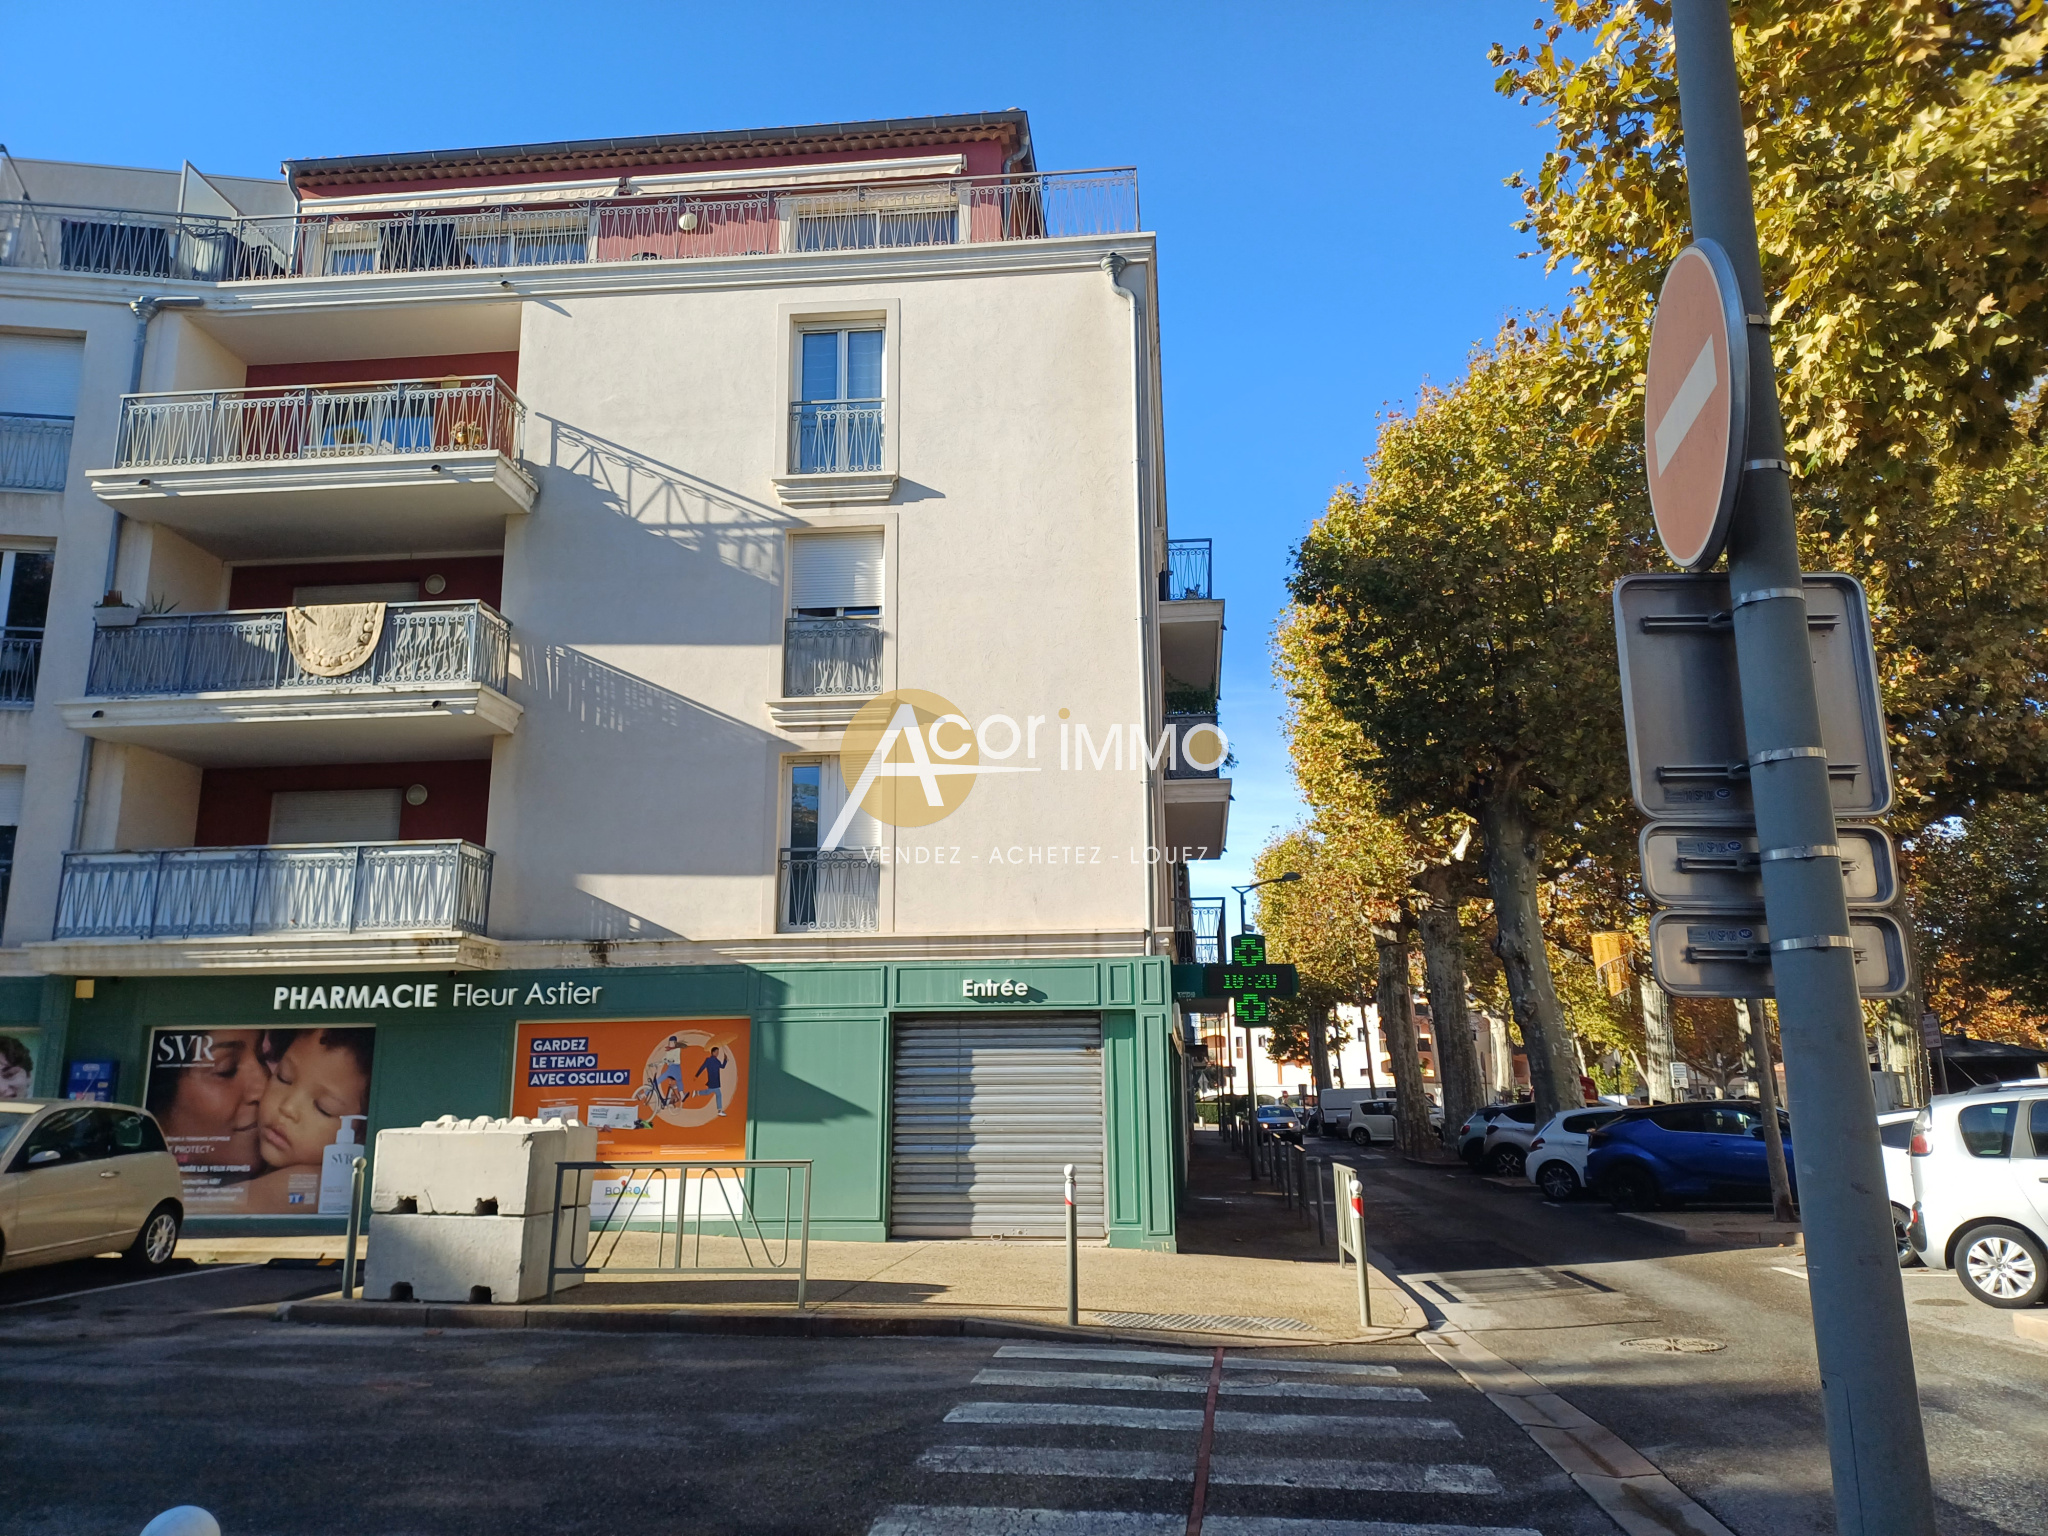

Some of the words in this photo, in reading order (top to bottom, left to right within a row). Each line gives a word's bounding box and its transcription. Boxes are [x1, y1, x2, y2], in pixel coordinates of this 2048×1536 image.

[962, 978, 1029, 997] Entrée
[273, 984, 438, 1010] PHARMACIE
[452, 983, 519, 1007] Fleur
[524, 982, 603, 1006] Astier
[157, 1035, 215, 1062] SVR
[533, 1040, 587, 1053] GARDEZ
[532, 1056, 547, 1068] LE
[550, 1055, 596, 1068] TEMPO
[530, 1073, 566, 1086] AVEC
[605, 1187, 649, 1195] BORON
